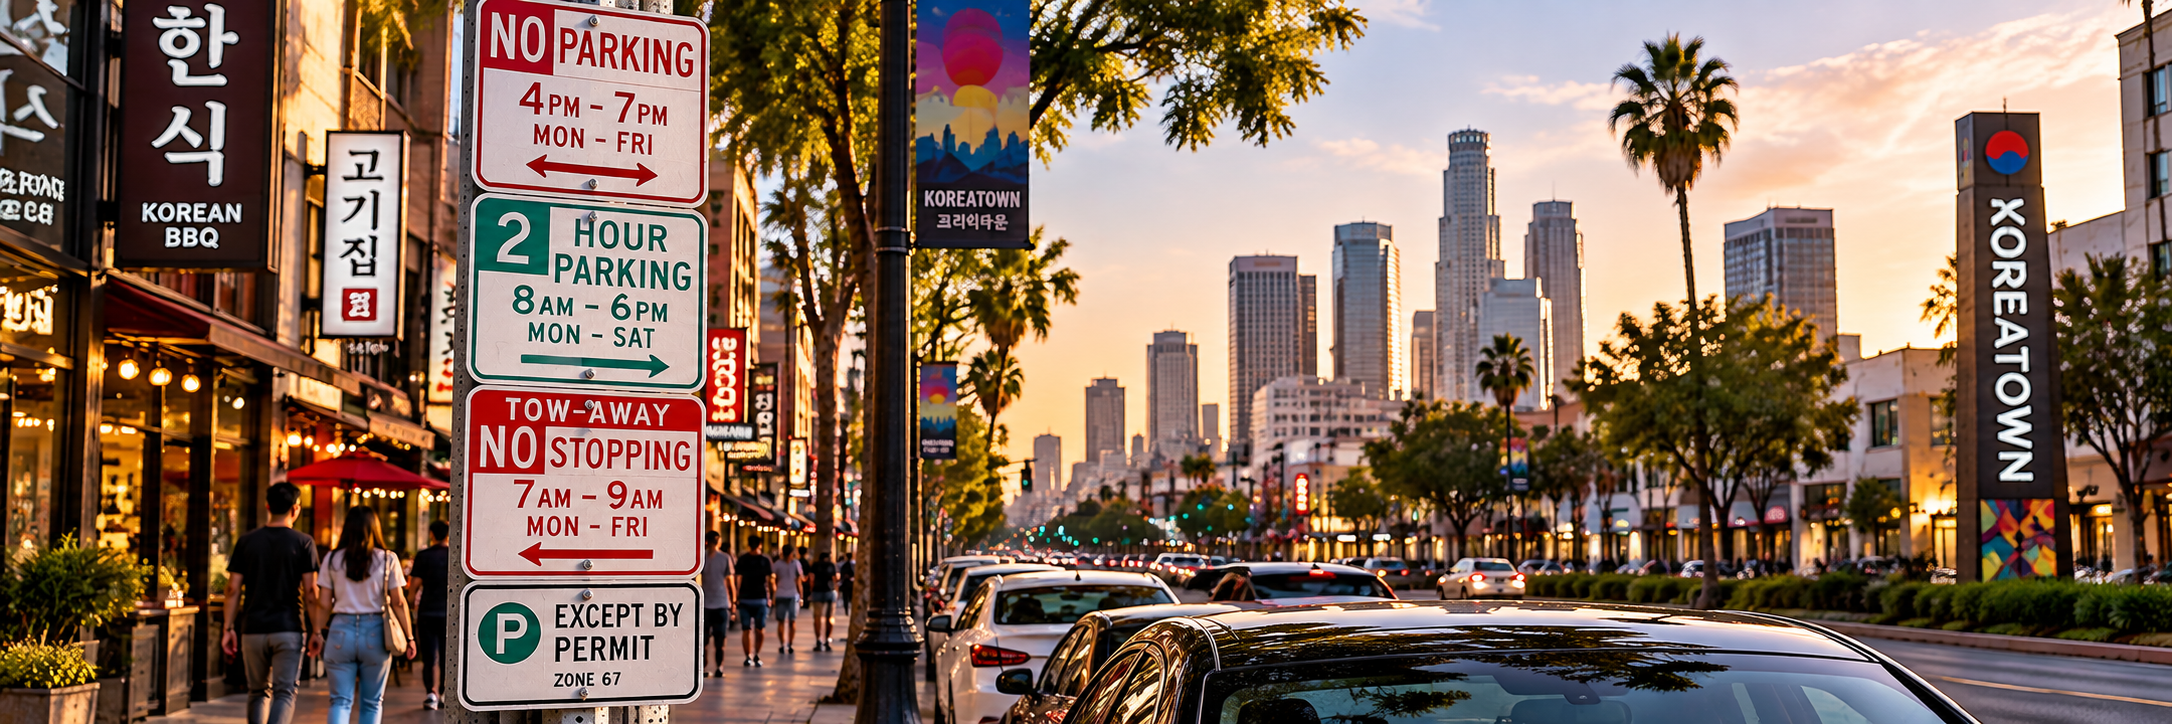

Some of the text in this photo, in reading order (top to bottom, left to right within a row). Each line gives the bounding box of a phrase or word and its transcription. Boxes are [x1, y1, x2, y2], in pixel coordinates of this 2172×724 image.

[490, 11, 694, 78] NO PARKING
[151, 3, 240, 187] 한식
[533, 123, 585, 149] MON
[617, 130, 653, 156] FRI
[141, 202, 242, 223] KOREAN
[340, 149, 384, 277] 고기집
[924, 190, 1021, 208] KOREATOWN
[164, 226, 219, 249] BBQ
[496, 211, 668, 265] 2 HOUR
[554, 253, 692, 292] PARKING
[527, 321, 581, 345] MON
[613, 326, 656, 349] SAT
[505, 396, 670, 427] TOW-AWAY
[479, 424, 537, 469] NO
[549, 436, 691, 472] STOPPING
[527, 515, 579, 537] MON
[611, 516, 648, 537] FRI
[555, 602, 684, 629] EXCEPT BY
[495, 612, 529, 656] P
[554, 634, 655, 663] PERMIT
[553, 671, 622, 688] ZONE 67
